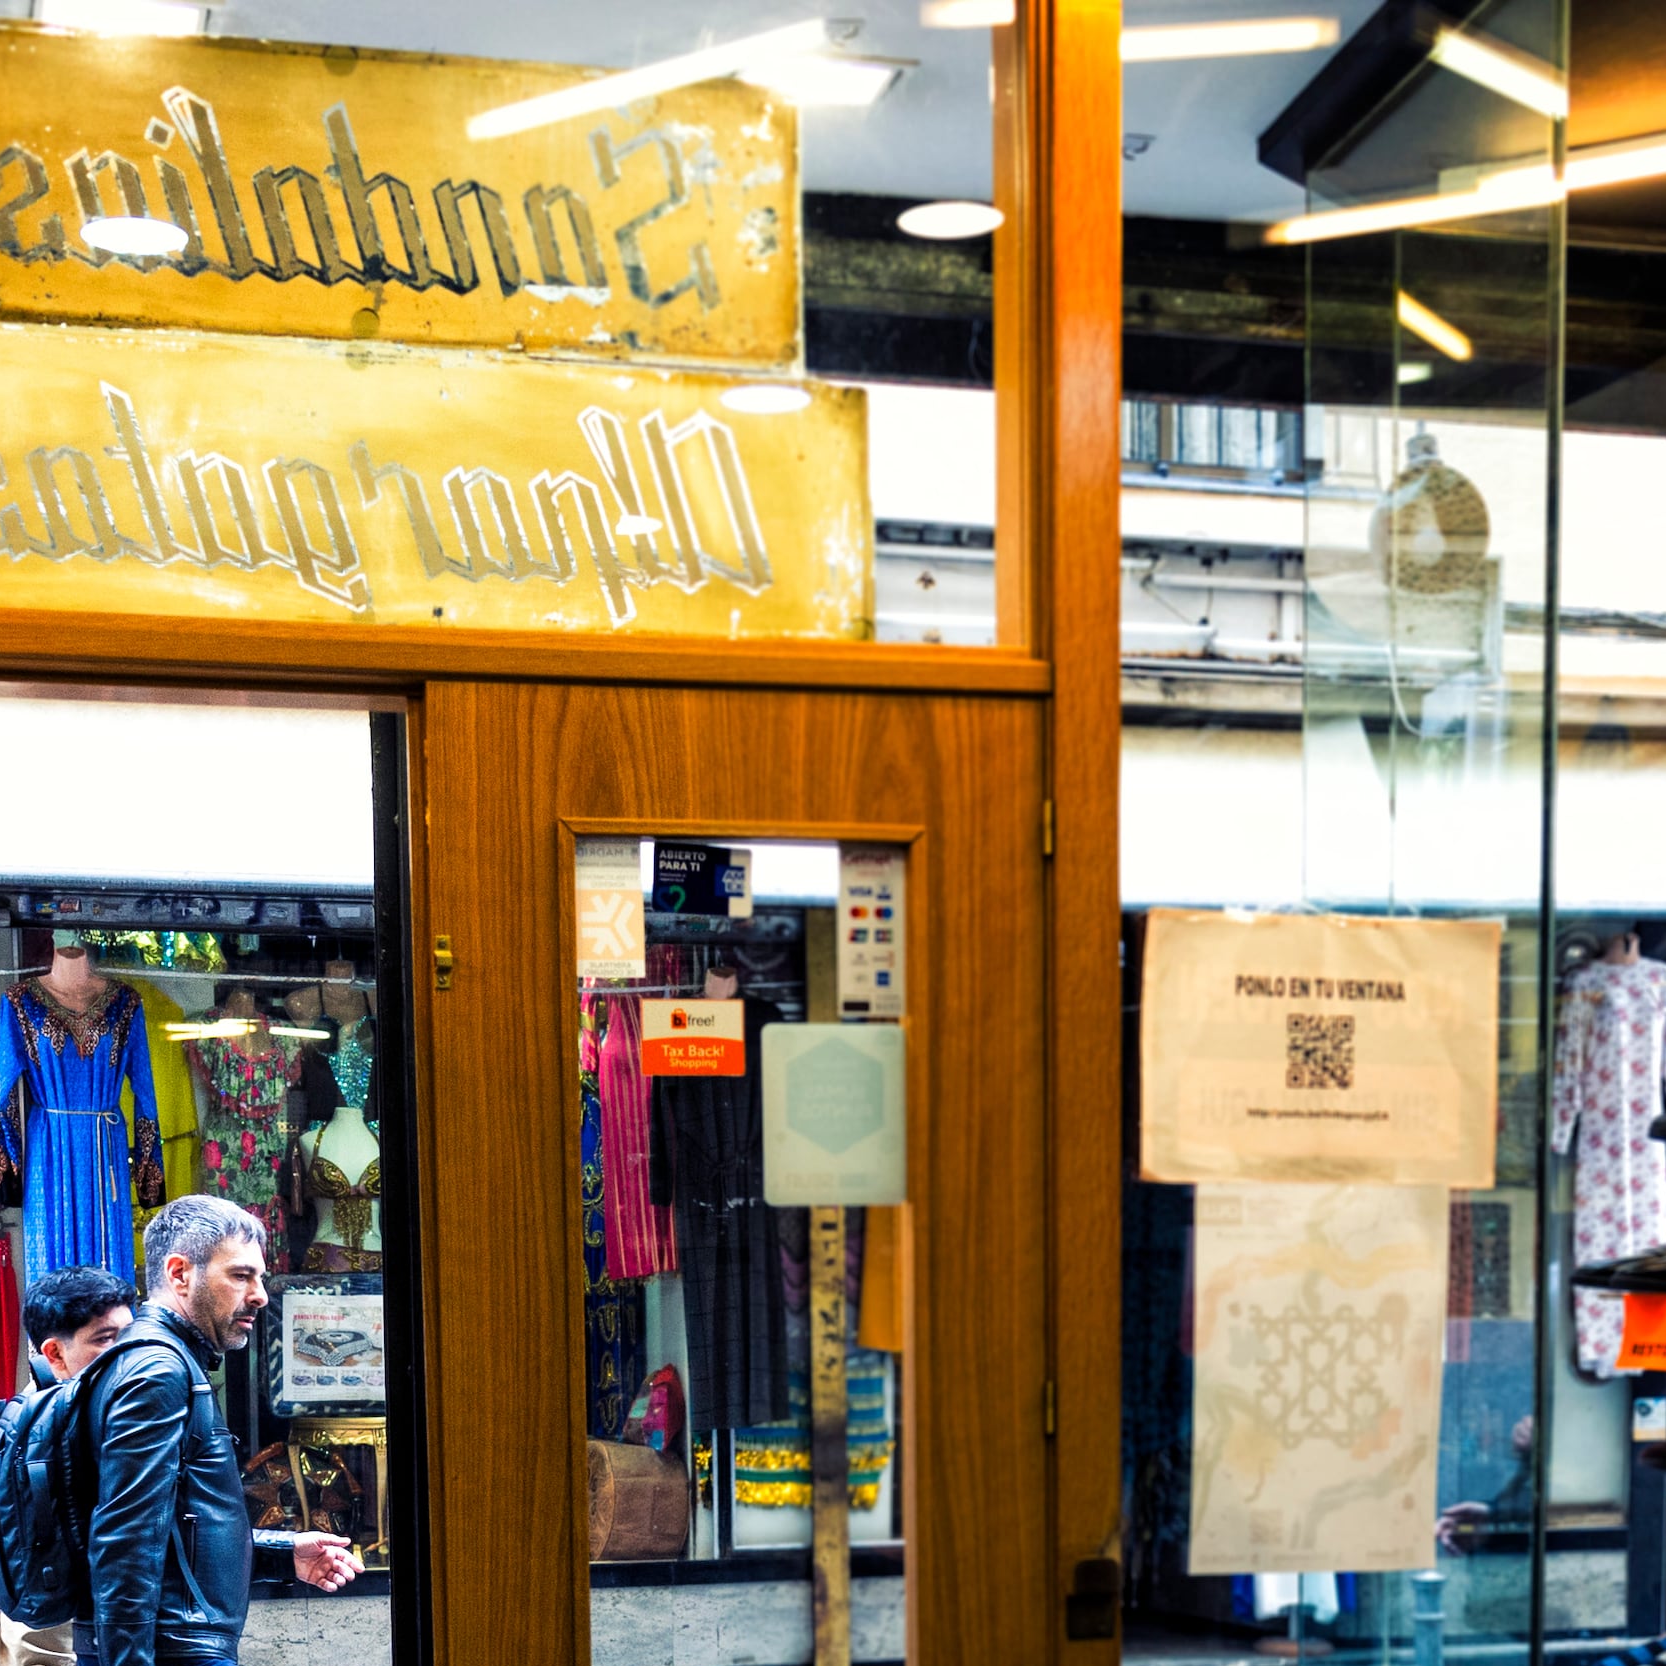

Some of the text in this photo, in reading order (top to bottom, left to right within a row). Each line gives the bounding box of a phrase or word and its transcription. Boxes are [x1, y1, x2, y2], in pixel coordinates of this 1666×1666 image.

[658, 849, 707, 862] ABIERTO
[658, 860, 688, 872] PARA
[690, 861, 701, 872] TI
[1234, 975, 1407, 1003] PONLO EN TU VENTANA
[662, 1044, 726, 1058] Tax Back!
[669, 1057, 718, 1069] Shopping
